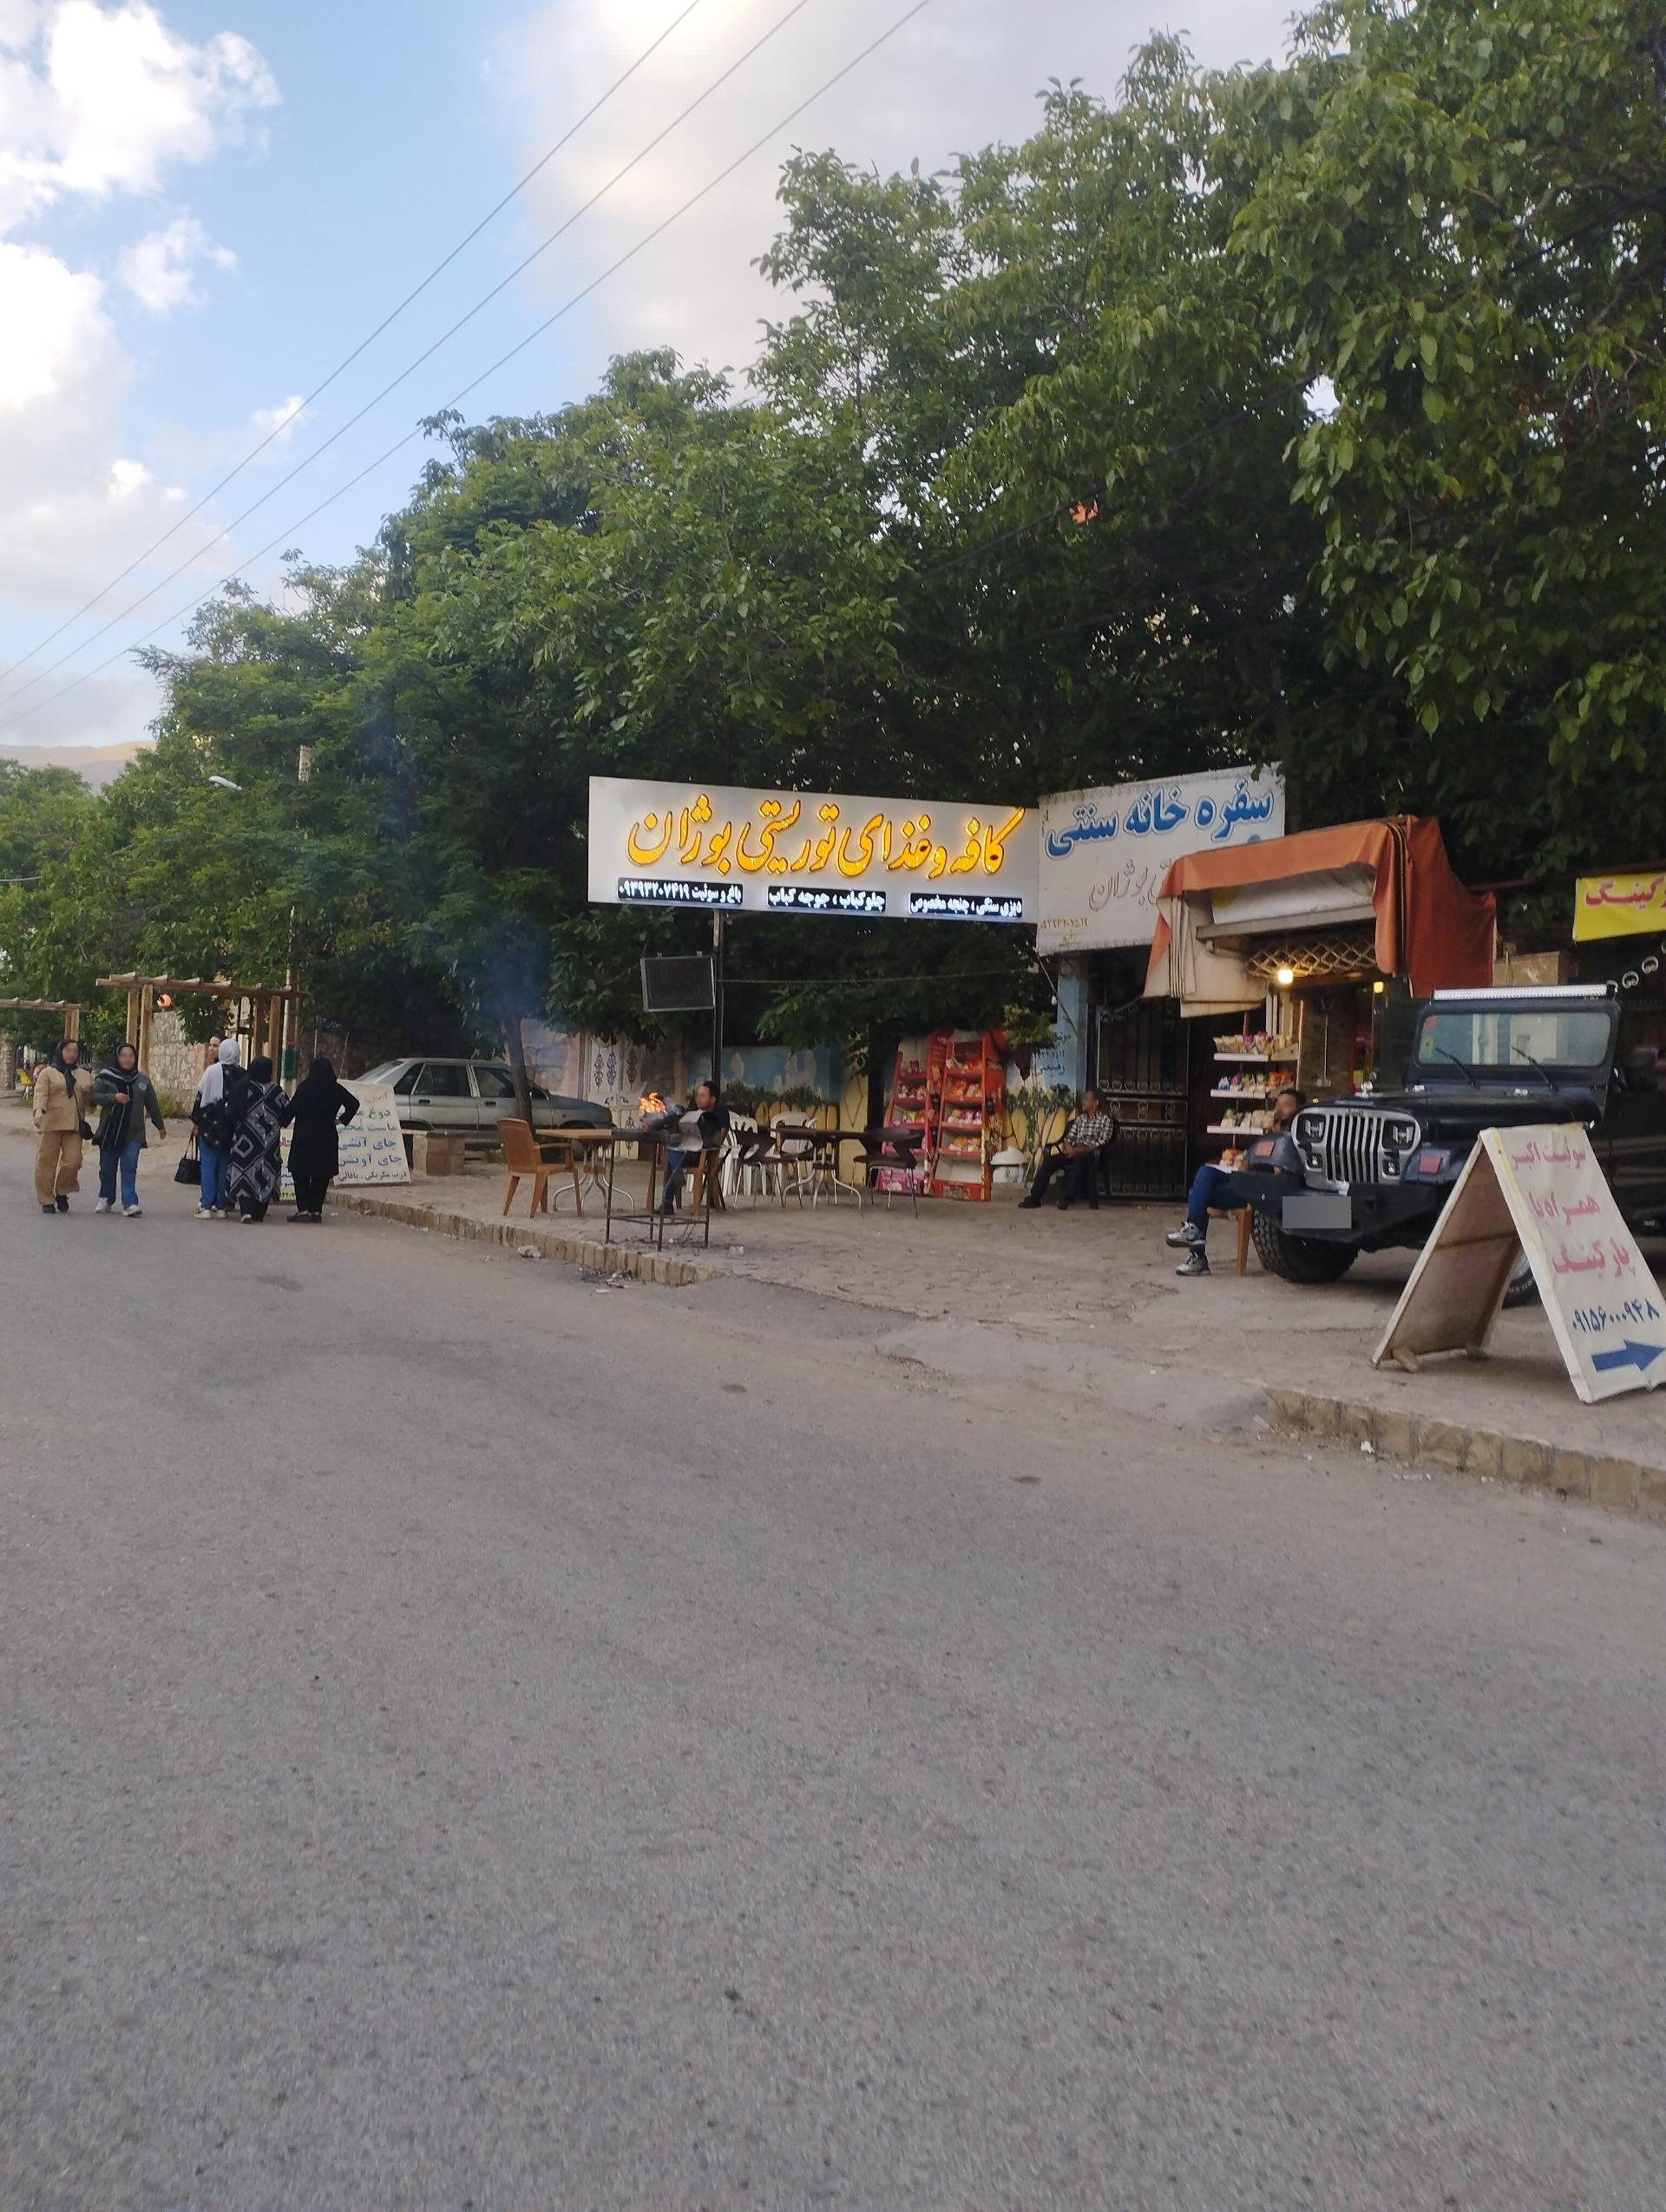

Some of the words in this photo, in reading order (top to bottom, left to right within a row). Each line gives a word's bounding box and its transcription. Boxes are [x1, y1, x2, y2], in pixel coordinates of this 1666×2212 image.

[1124, 784, 1190, 836] خانه
[1195, 779, 1274, 843] سفره
[626, 793, 732, 875] بوژان
[735, 799, 840, 874] توریستی
[948, 806, 1026, 874] کافه
[1045, 803, 1120, 860] سنتی
[769, 887, 797, 906] کباب
[798, 890, 830, 909] جوجه
[369, 1107, 390, 1120] دوغ
[373, 1137, 397, 1150] چای
[378, 1155, 402, 1167] چای
[1511, 1141, 1542, 1171] اکبر
